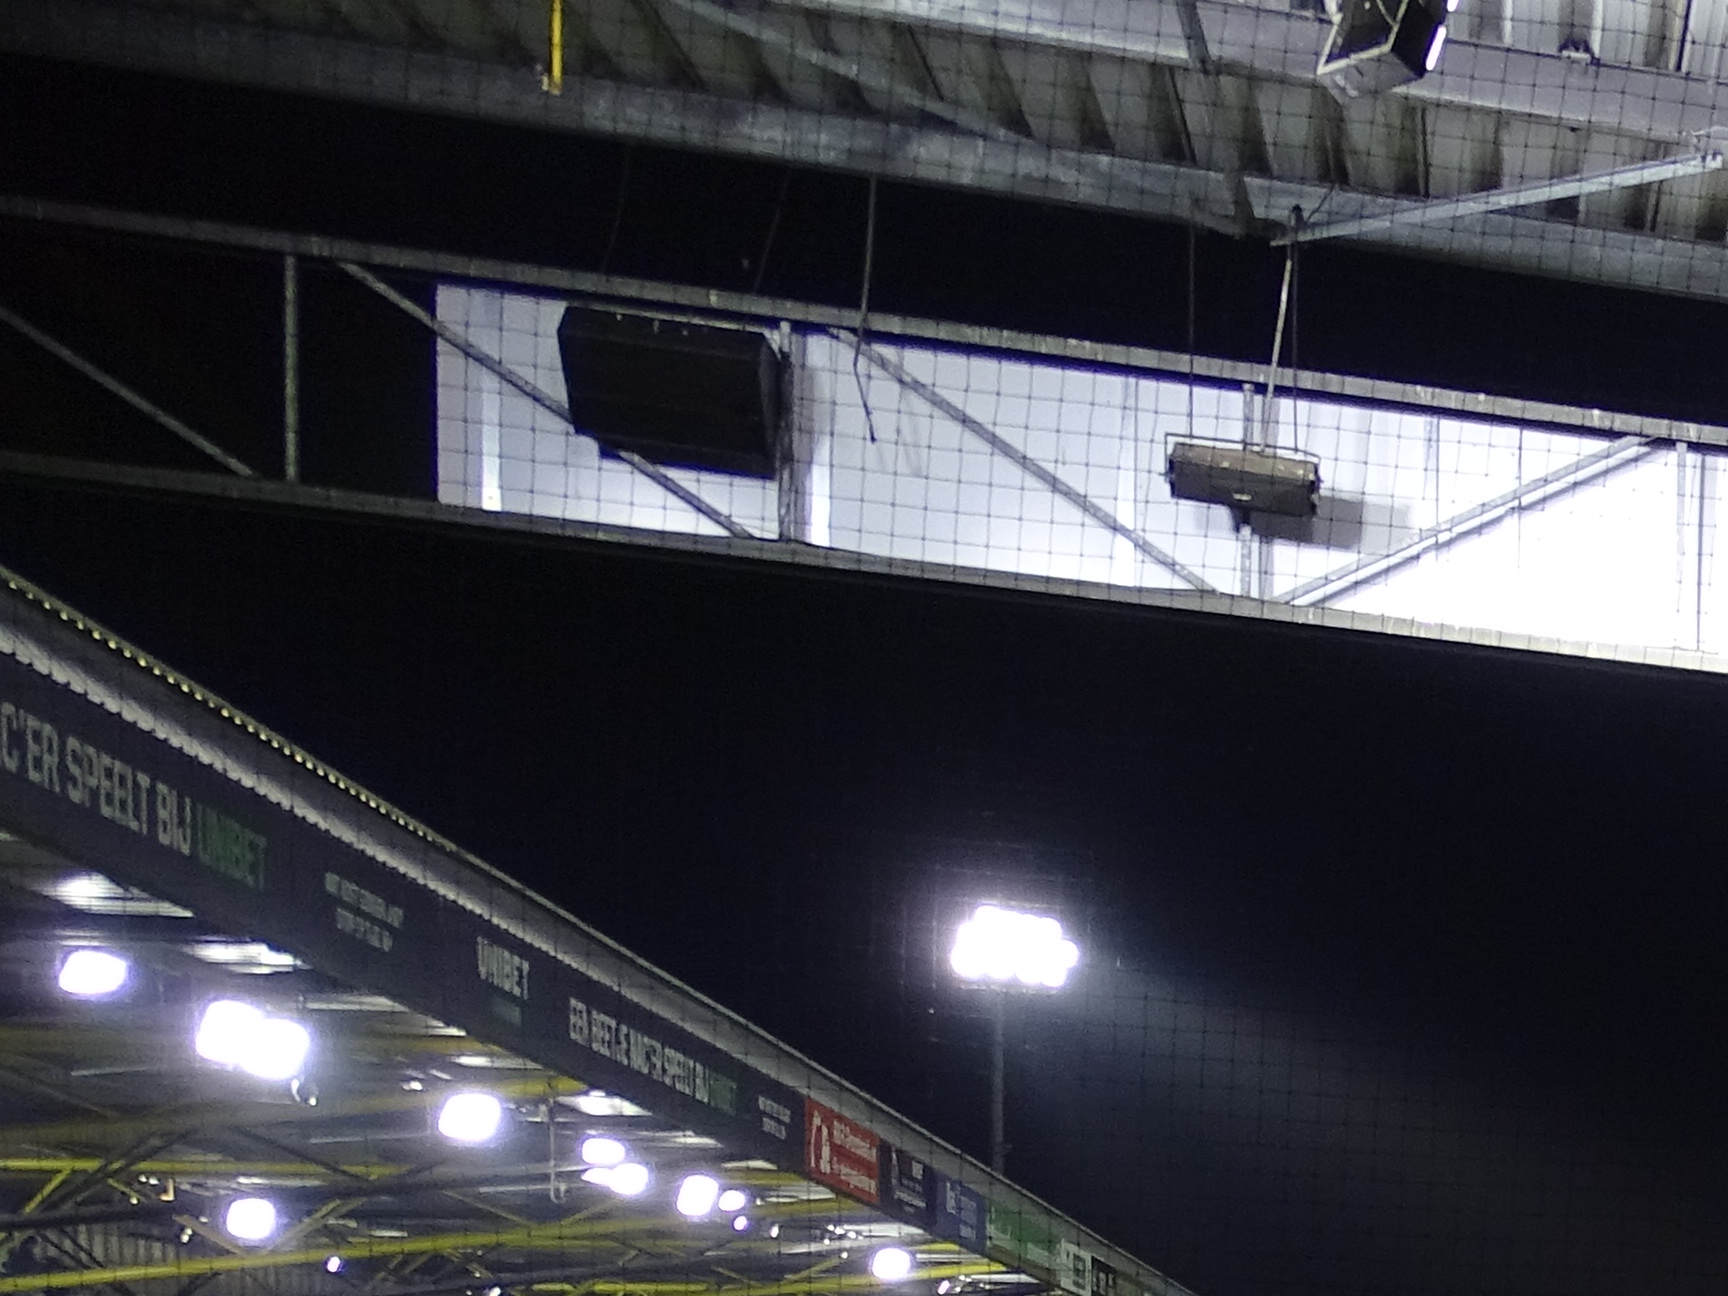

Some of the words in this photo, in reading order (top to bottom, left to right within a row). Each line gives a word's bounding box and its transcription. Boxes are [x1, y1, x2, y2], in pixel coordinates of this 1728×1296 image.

[66, 735, 151, 834] SPEELT
[155, 783, 192, 856] BIJ
[477, 936, 530, 1000] UNIBET
